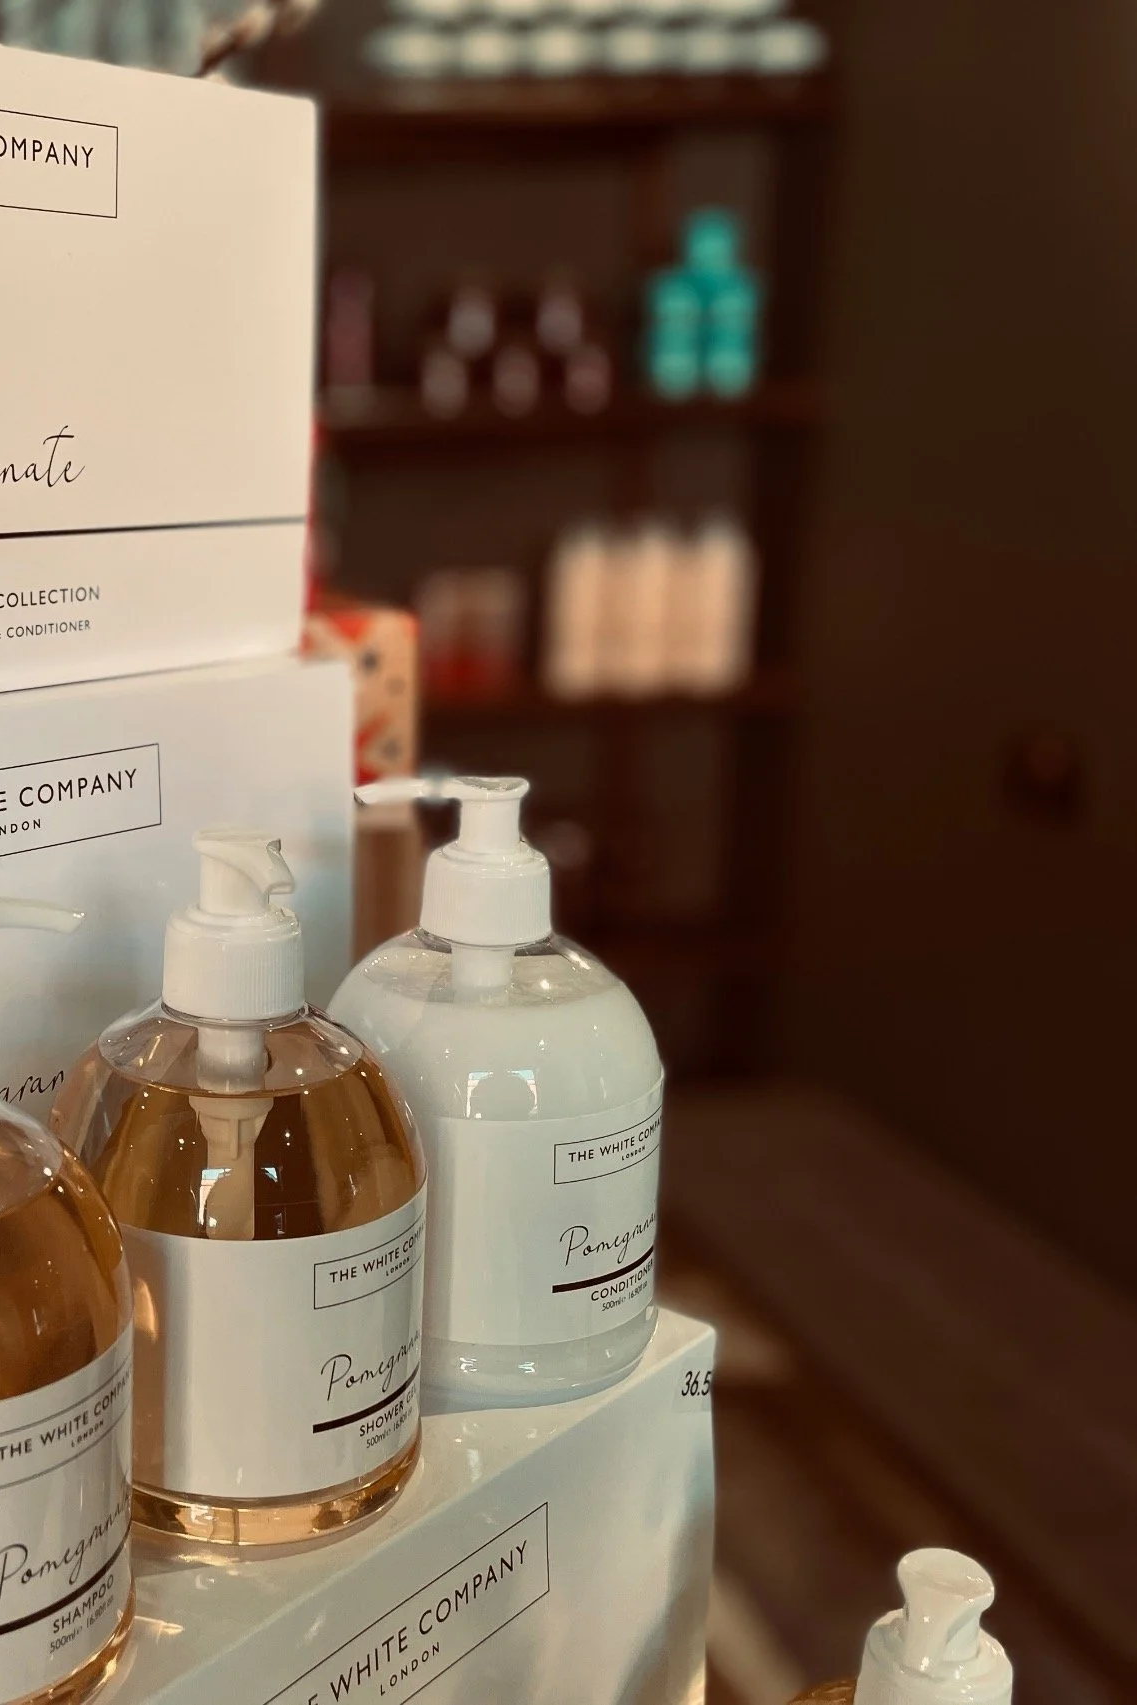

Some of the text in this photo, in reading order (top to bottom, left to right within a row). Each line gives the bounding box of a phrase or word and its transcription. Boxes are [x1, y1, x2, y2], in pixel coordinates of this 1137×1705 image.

[6, 619, 91, 639] CONDITIONER
[19, 768, 137, 807] COMPANY
[568, 1149, 594, 1162] THE
[600, 1136, 635, 1156] WHITE
[621, 1145, 646, 1161] LONDON
[559, 1213, 656, 1267] Pomegrana
[329, 1266, 357, 1283] THE
[363, 1247, 400, 1274] WHITE
[386, 1256, 410, 1277] LONDON
[40, 1410, 89, 1446] WHITE
[70, 1420, 104, 1448] LONDON
[359, 1400, 404, 1437] SHOWER
[53, 1574, 114, 1634] SHAMPOO
[329, 1540, 527, 1703] WHITE COMPANY
[379, 1641, 440, 1697] LONDON
